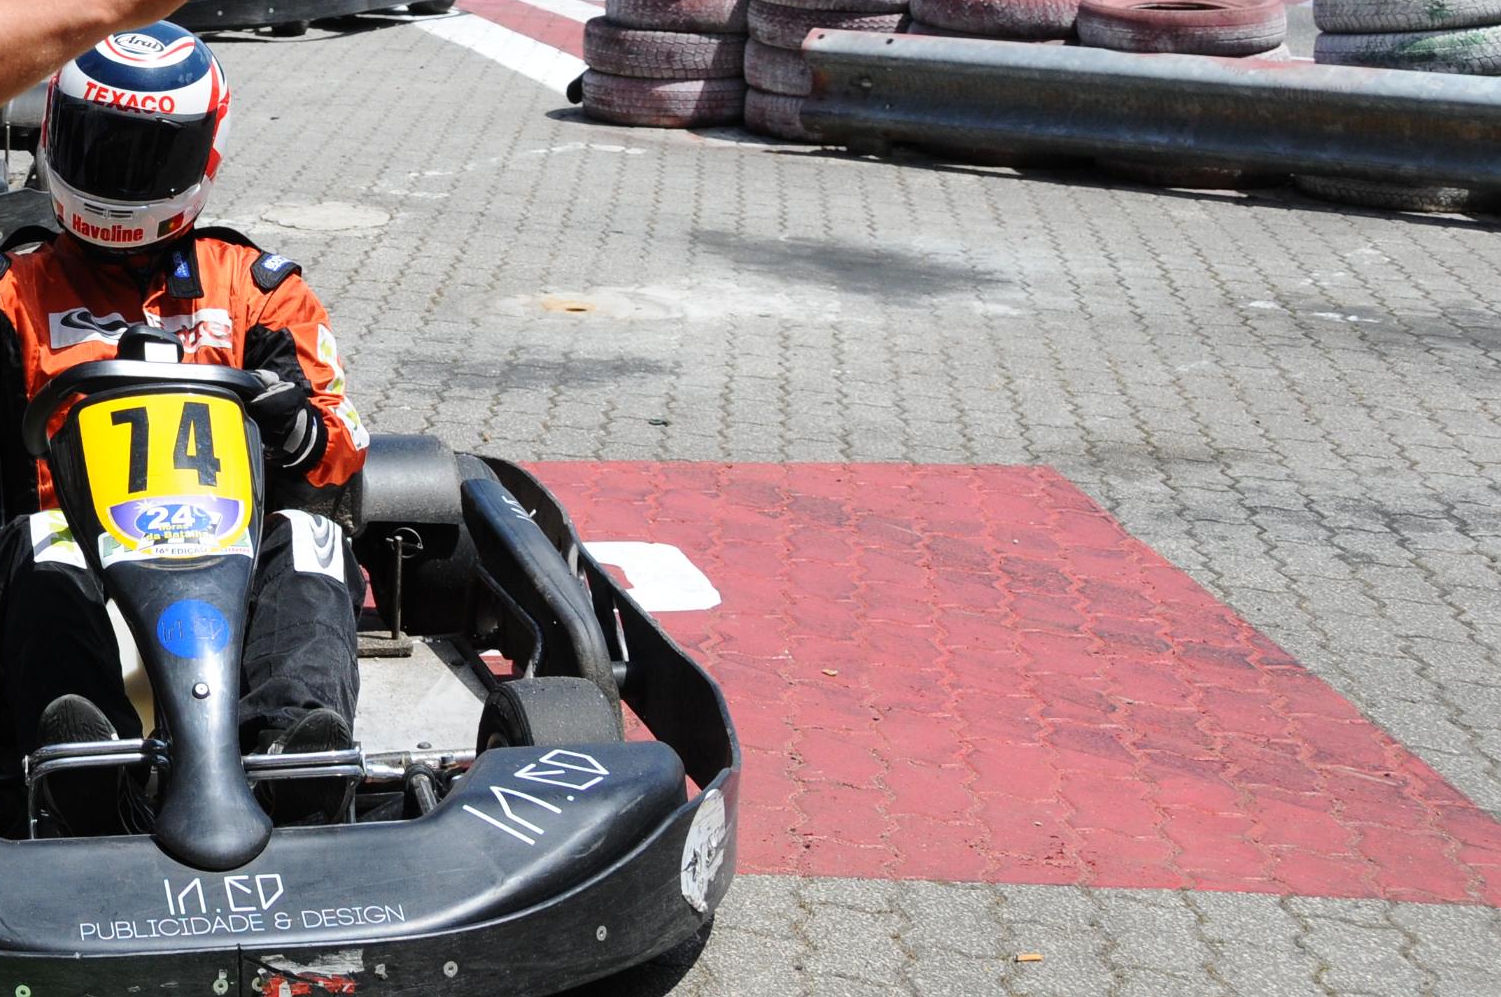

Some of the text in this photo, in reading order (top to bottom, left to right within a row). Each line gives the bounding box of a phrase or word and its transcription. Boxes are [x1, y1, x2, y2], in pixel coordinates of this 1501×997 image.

[115, 34, 166, 54] Arai
[83, 81, 176, 115] TEXACO
[72, 213, 145, 244] Havoline
[145, 505, 197, 531] 24
[79, 903, 406, 942] PUBLICIDADE & DESIGN
